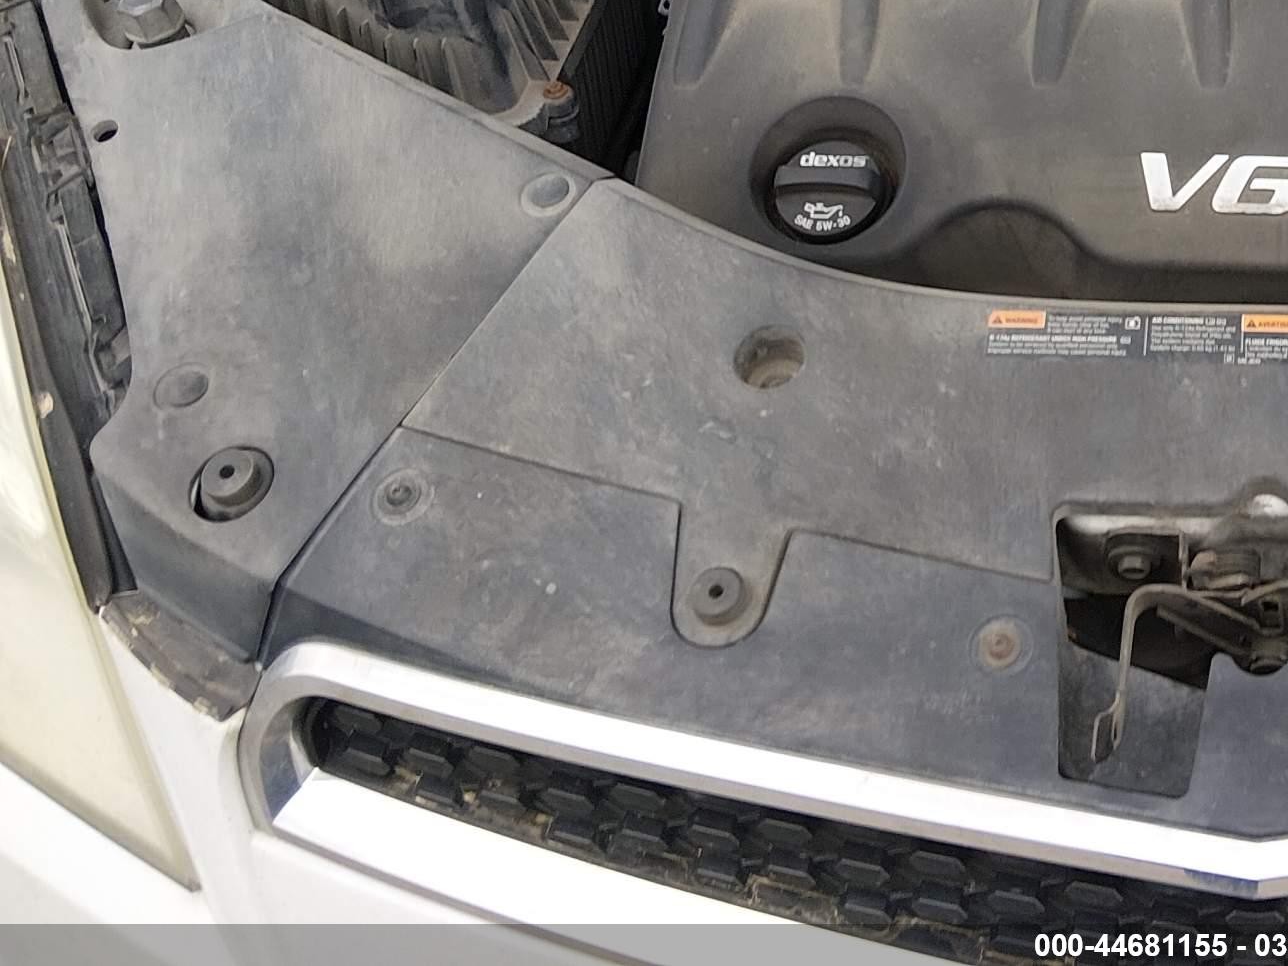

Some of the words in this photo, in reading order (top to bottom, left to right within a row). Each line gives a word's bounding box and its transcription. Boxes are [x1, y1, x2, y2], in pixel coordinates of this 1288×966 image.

[799, 151, 868, 168] dexos
[794, 214, 814, 231] SAE
[815, 216, 851, 231] 5W-30
